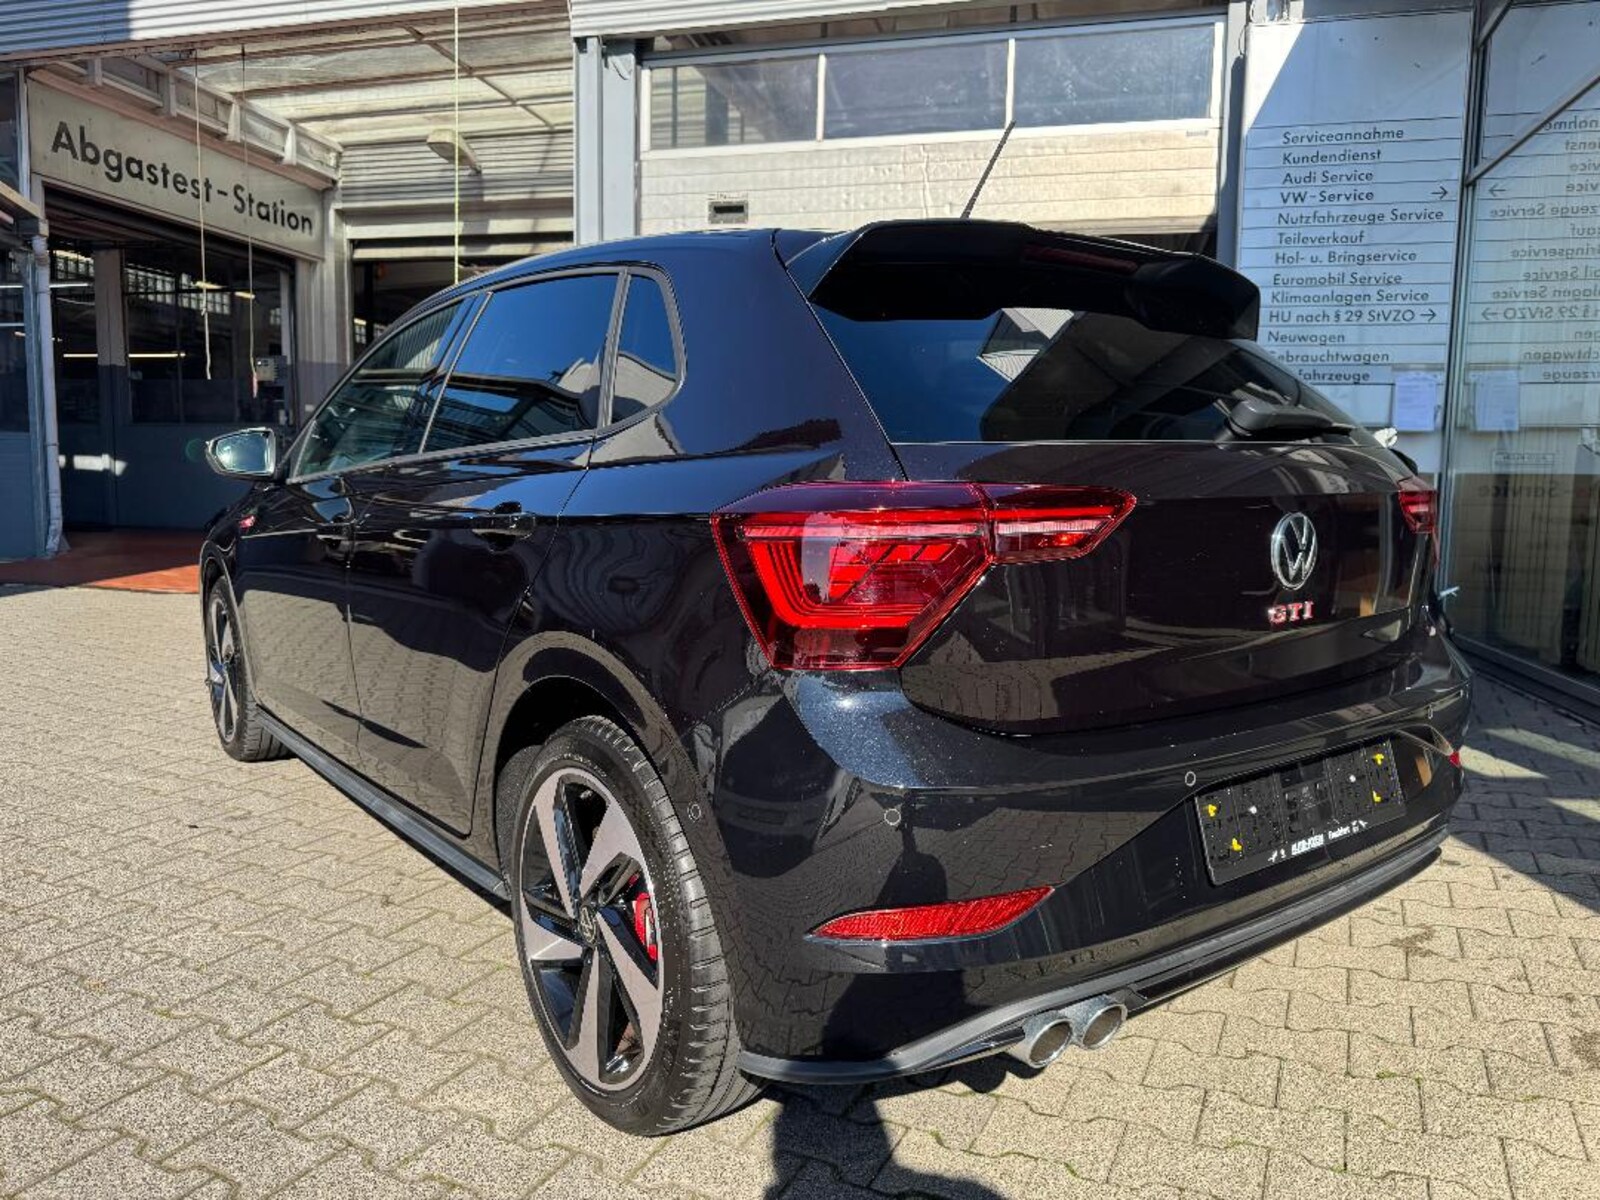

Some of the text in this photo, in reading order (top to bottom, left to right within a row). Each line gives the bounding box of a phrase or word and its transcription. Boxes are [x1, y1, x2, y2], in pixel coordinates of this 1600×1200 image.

[1282, 127, 1404, 144] Serviceannahme
[1282, 150, 1381, 165] Kundendienst
[51, 121, 314, 236] Abgastest-Station
[1282, 169, 1374, 185] Audi Service
[1278, 208, 1444, 225] Nutzfahrzeuge Service
[1278, 230, 1365, 245] Teileverkauf
[1275, 250, 1417, 266] Hol- u. Bringservice
[1273, 272, 1403, 285] Euromobil Service
[1271, 289, 1429, 305] Klimaanlagen Service
[1269, 309, 1415, 323] HU nach § 29 StVZO
[1267, 331, 1345, 345] Neuwagen
[1269, 350, 1389, 365] ebrauchtwagen
[1268, 601, 1314, 623] GTI
